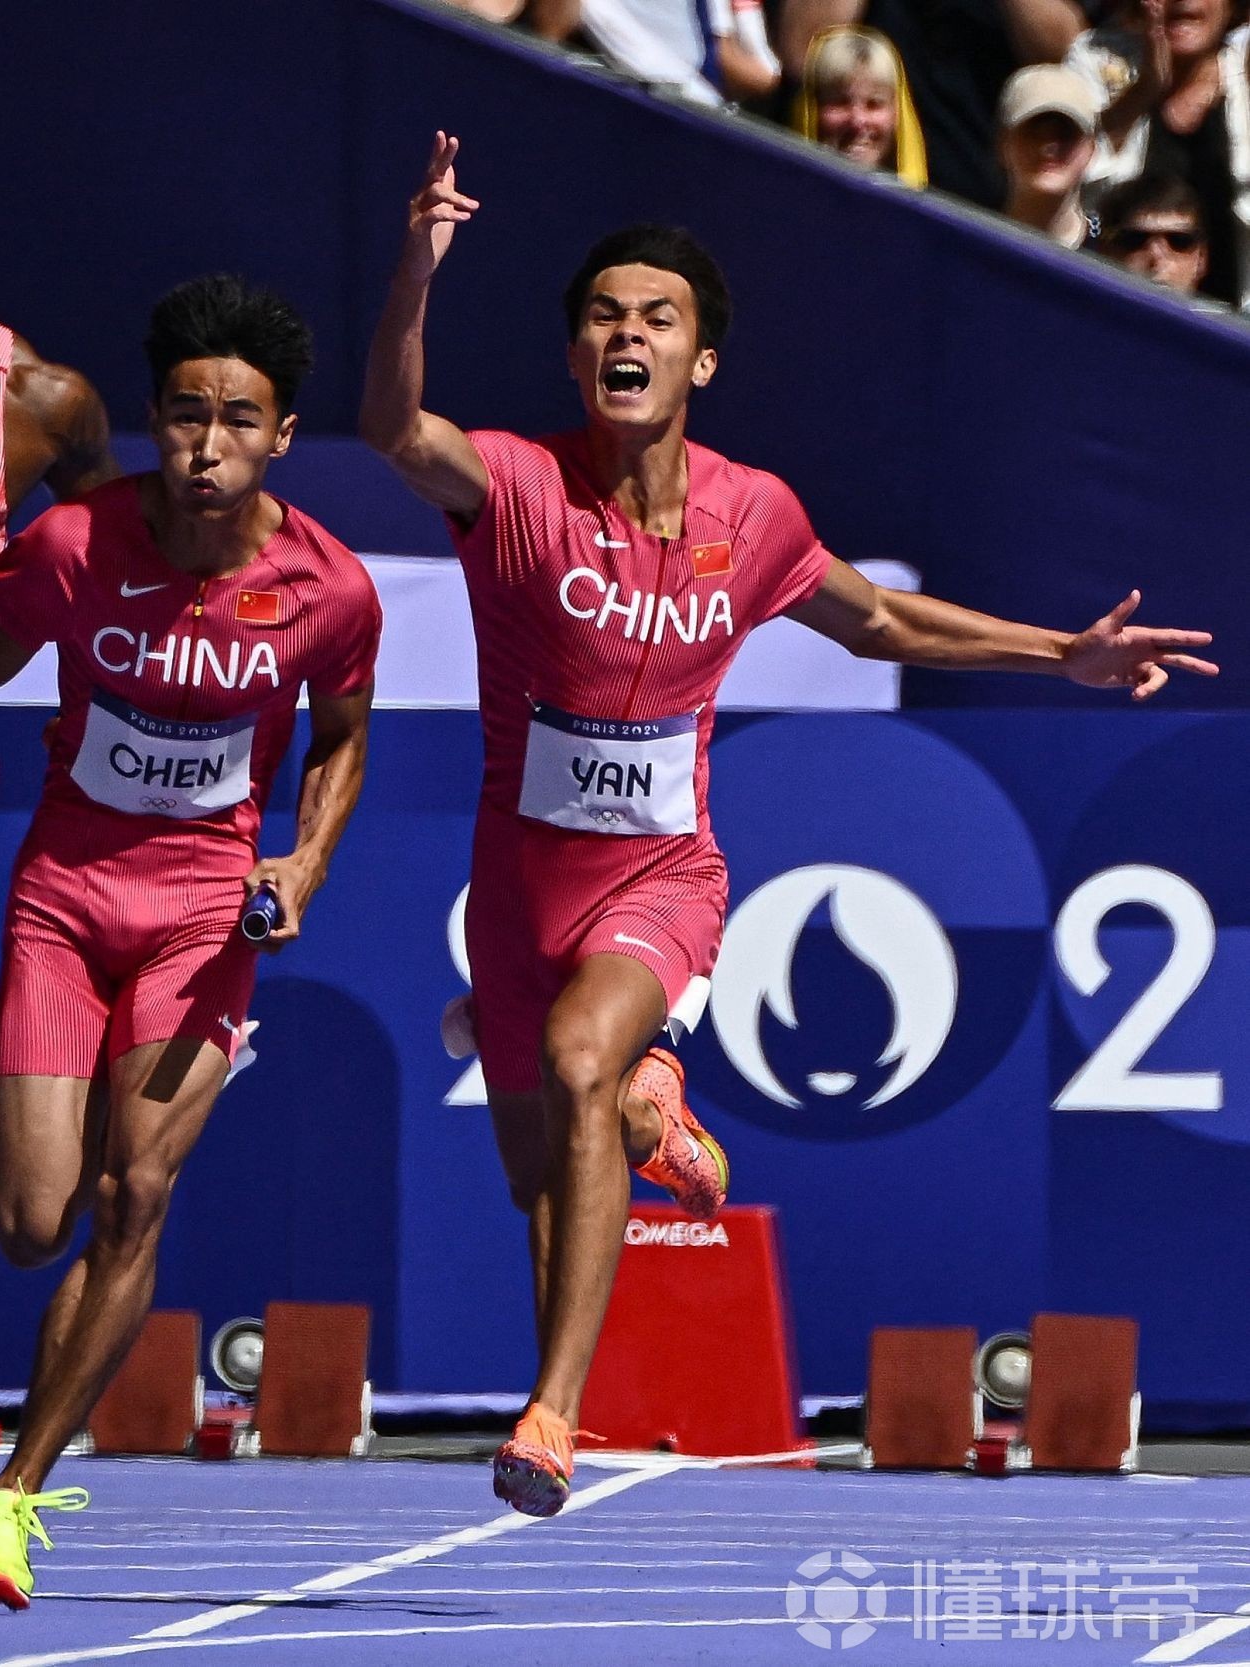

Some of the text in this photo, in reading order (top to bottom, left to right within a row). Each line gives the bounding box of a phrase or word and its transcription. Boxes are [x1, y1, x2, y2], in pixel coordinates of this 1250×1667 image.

[559, 566, 734, 645] CHINA
[92, 626, 280, 690] CHINA
[130, 711, 219, 737] PARIS 2024
[573, 720, 660, 736] PARIS 2024
[109, 742, 225, 789] CHEN
[570, 756, 654, 798] YAN
[623, 1218, 730, 1247] OMEGA
